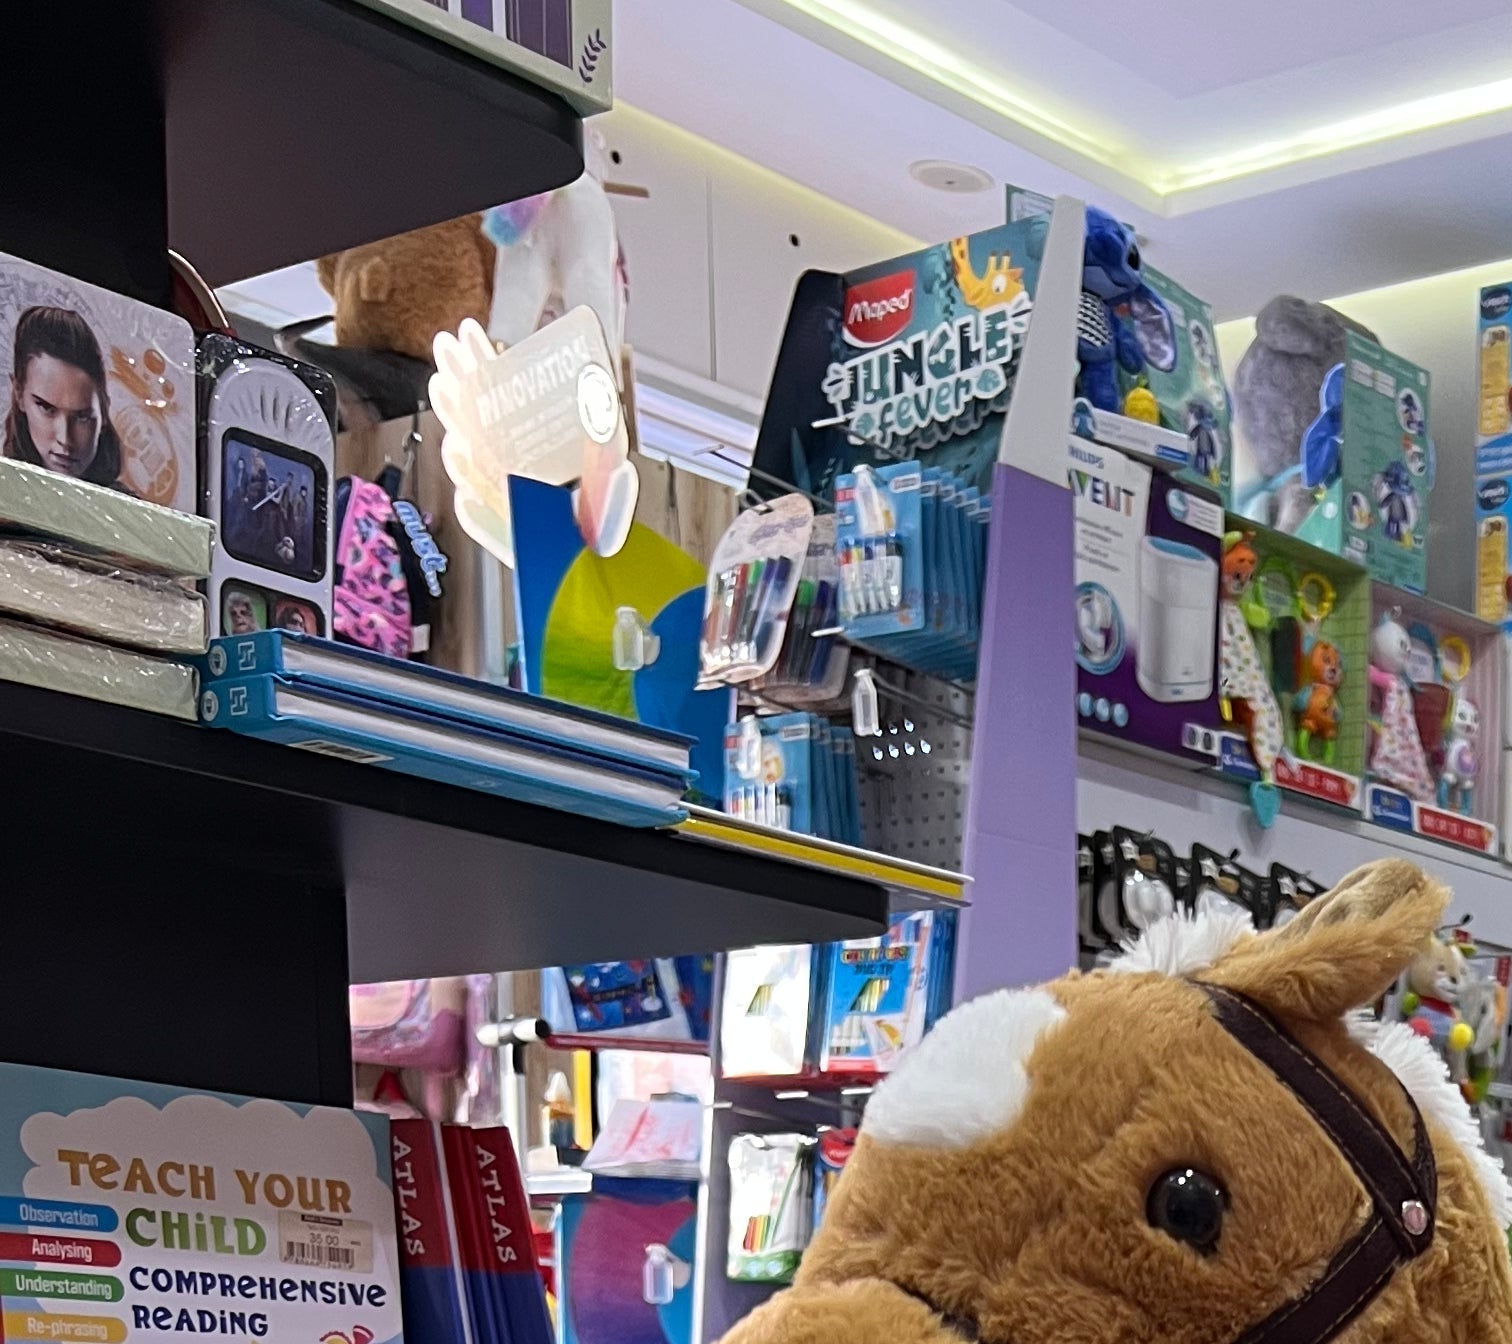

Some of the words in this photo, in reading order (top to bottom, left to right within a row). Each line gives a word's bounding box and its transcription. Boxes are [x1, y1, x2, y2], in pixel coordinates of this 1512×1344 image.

[849, 289, 912, 324] Maped
[236, 1169, 352, 1214] YOUR
[393, 1135, 426, 1256] ATLAS
[476, 1144, 518, 1264] ATLAS
[19, 1203, 99, 1227] Observation
[32, 1238, 93, 1263] Analysing
[15, 1275, 112, 1300] Understanding
[28, 1317, 109, 1340] Re-phrasing
